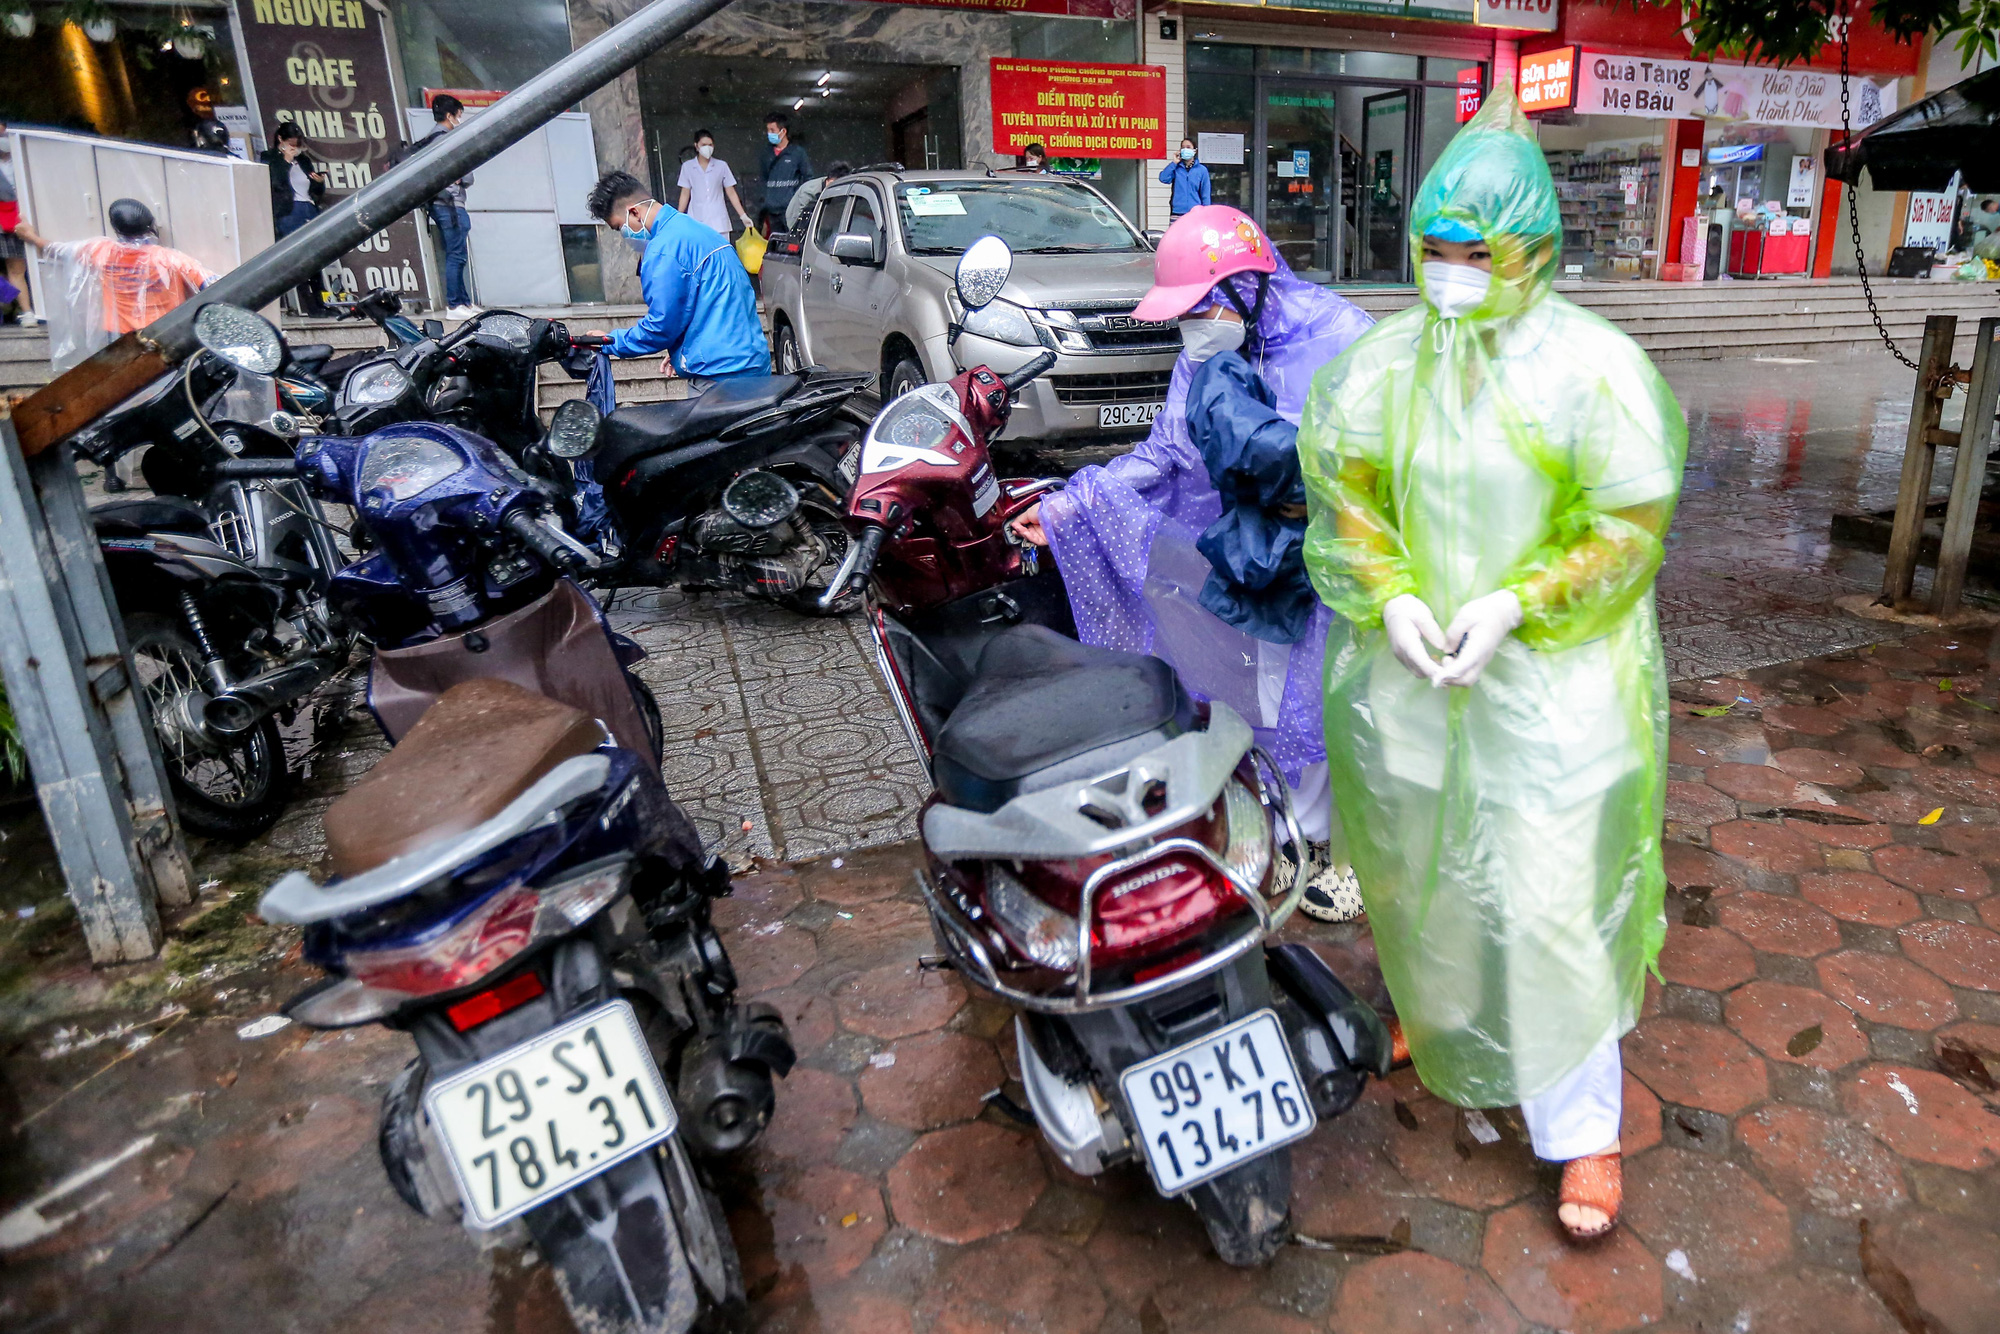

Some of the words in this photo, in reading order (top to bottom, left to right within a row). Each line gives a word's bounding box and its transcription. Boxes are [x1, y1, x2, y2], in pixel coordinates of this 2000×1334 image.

[286, 57, 358, 87] CAFE
[1521, 63, 1545, 84] SỮA
[1547, 58, 1570, 80] BỈM
[1593, 58, 1636, 82] Quà
[1640, 62, 1691, 91] Tặng
[1037, 87, 1065, 107] ĐIỂM
[1068, 93, 1095, 110] TRỰC
[1098, 91, 1125, 108] CHỐT
[1522, 84, 1541, 103] GIÁ
[1543, 80, 1567, 100] TỐT
[1603, 87, 1631, 113] Mẹ
[1636, 89, 1674, 112] Bầu
[351, 102, 386, 139] TỐ
[1001, 111, 1034, 127] TUYÊN
[1036, 110, 1073, 128] TRUYỀN
[1075, 114, 1089, 128] VÀ
[1091, 112, 1105, 129] XỬ
[1106, 114, 1118, 129] LÝ
[1119, 118, 1129, 129] VI
[1131, 118, 1159, 132] PHẠM
[1050, 131, 1083, 148] CHỐNG
[1085, 136, 1108, 150] DỊCH
[1110, 136, 1153, 150] COVID-19
[365, 258, 419, 292] QUẢ
[268, 510, 296, 526] HONDA
[1112, 862, 1187, 899] HONDA
[466, 1026, 615, 1140] 29-S1
[1150, 1032, 1265, 1117] 99-K1
[472, 1078, 656, 1210] 784.31
[1157, 1080, 1301, 1178] 134.76
